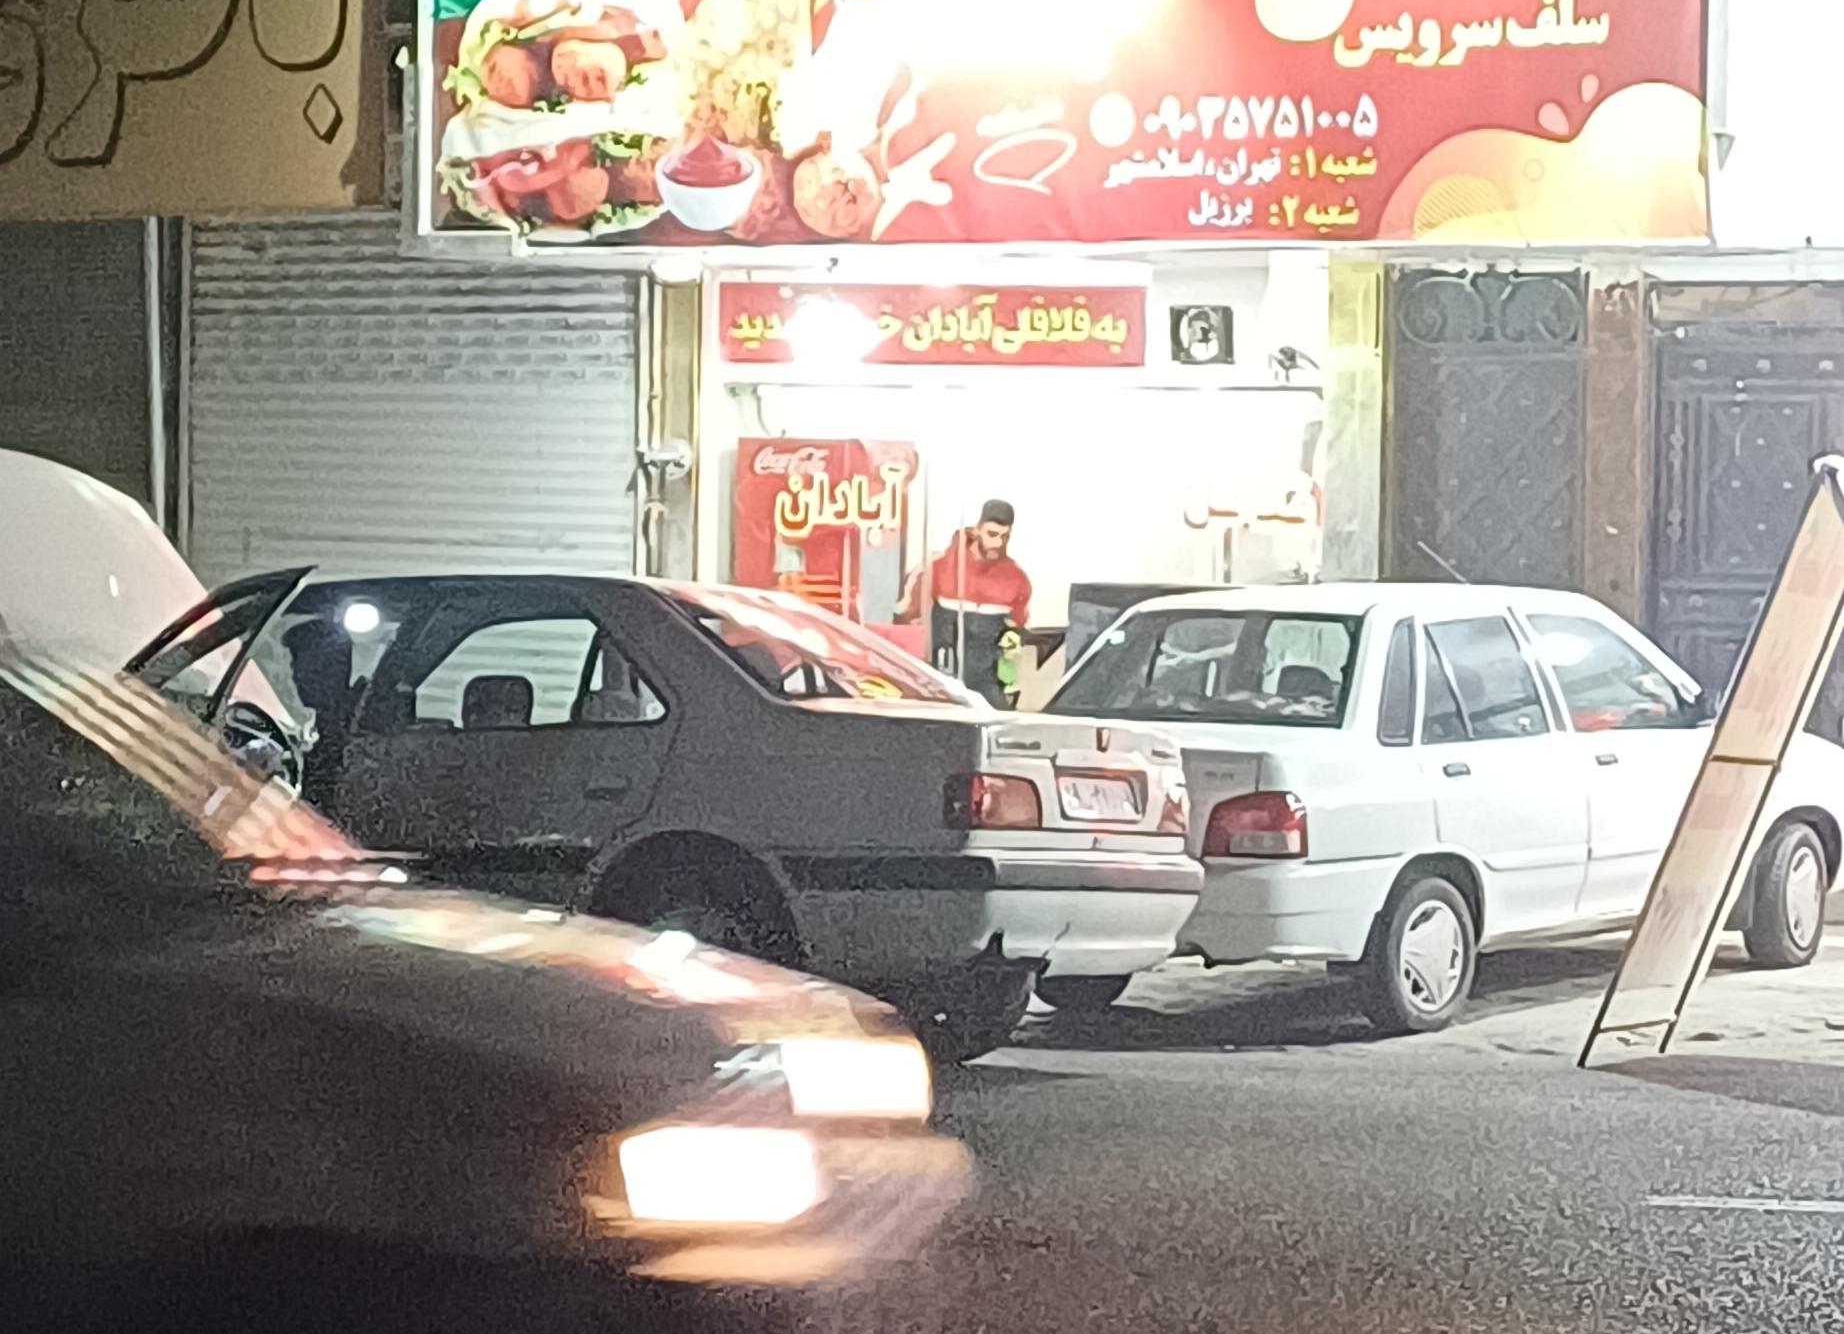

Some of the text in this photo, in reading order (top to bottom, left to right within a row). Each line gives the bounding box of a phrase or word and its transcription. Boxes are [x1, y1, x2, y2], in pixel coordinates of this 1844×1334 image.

[1333, 11, 1502, 68] سرویس
[1321, 146, 1378, 183] شعبه
[1303, 196, 1360, 234] شعبه
[902, 293, 998, 353] آبادان
[1090, 314, 1128, 353] به
[774, 460, 909, 548] آبادان
